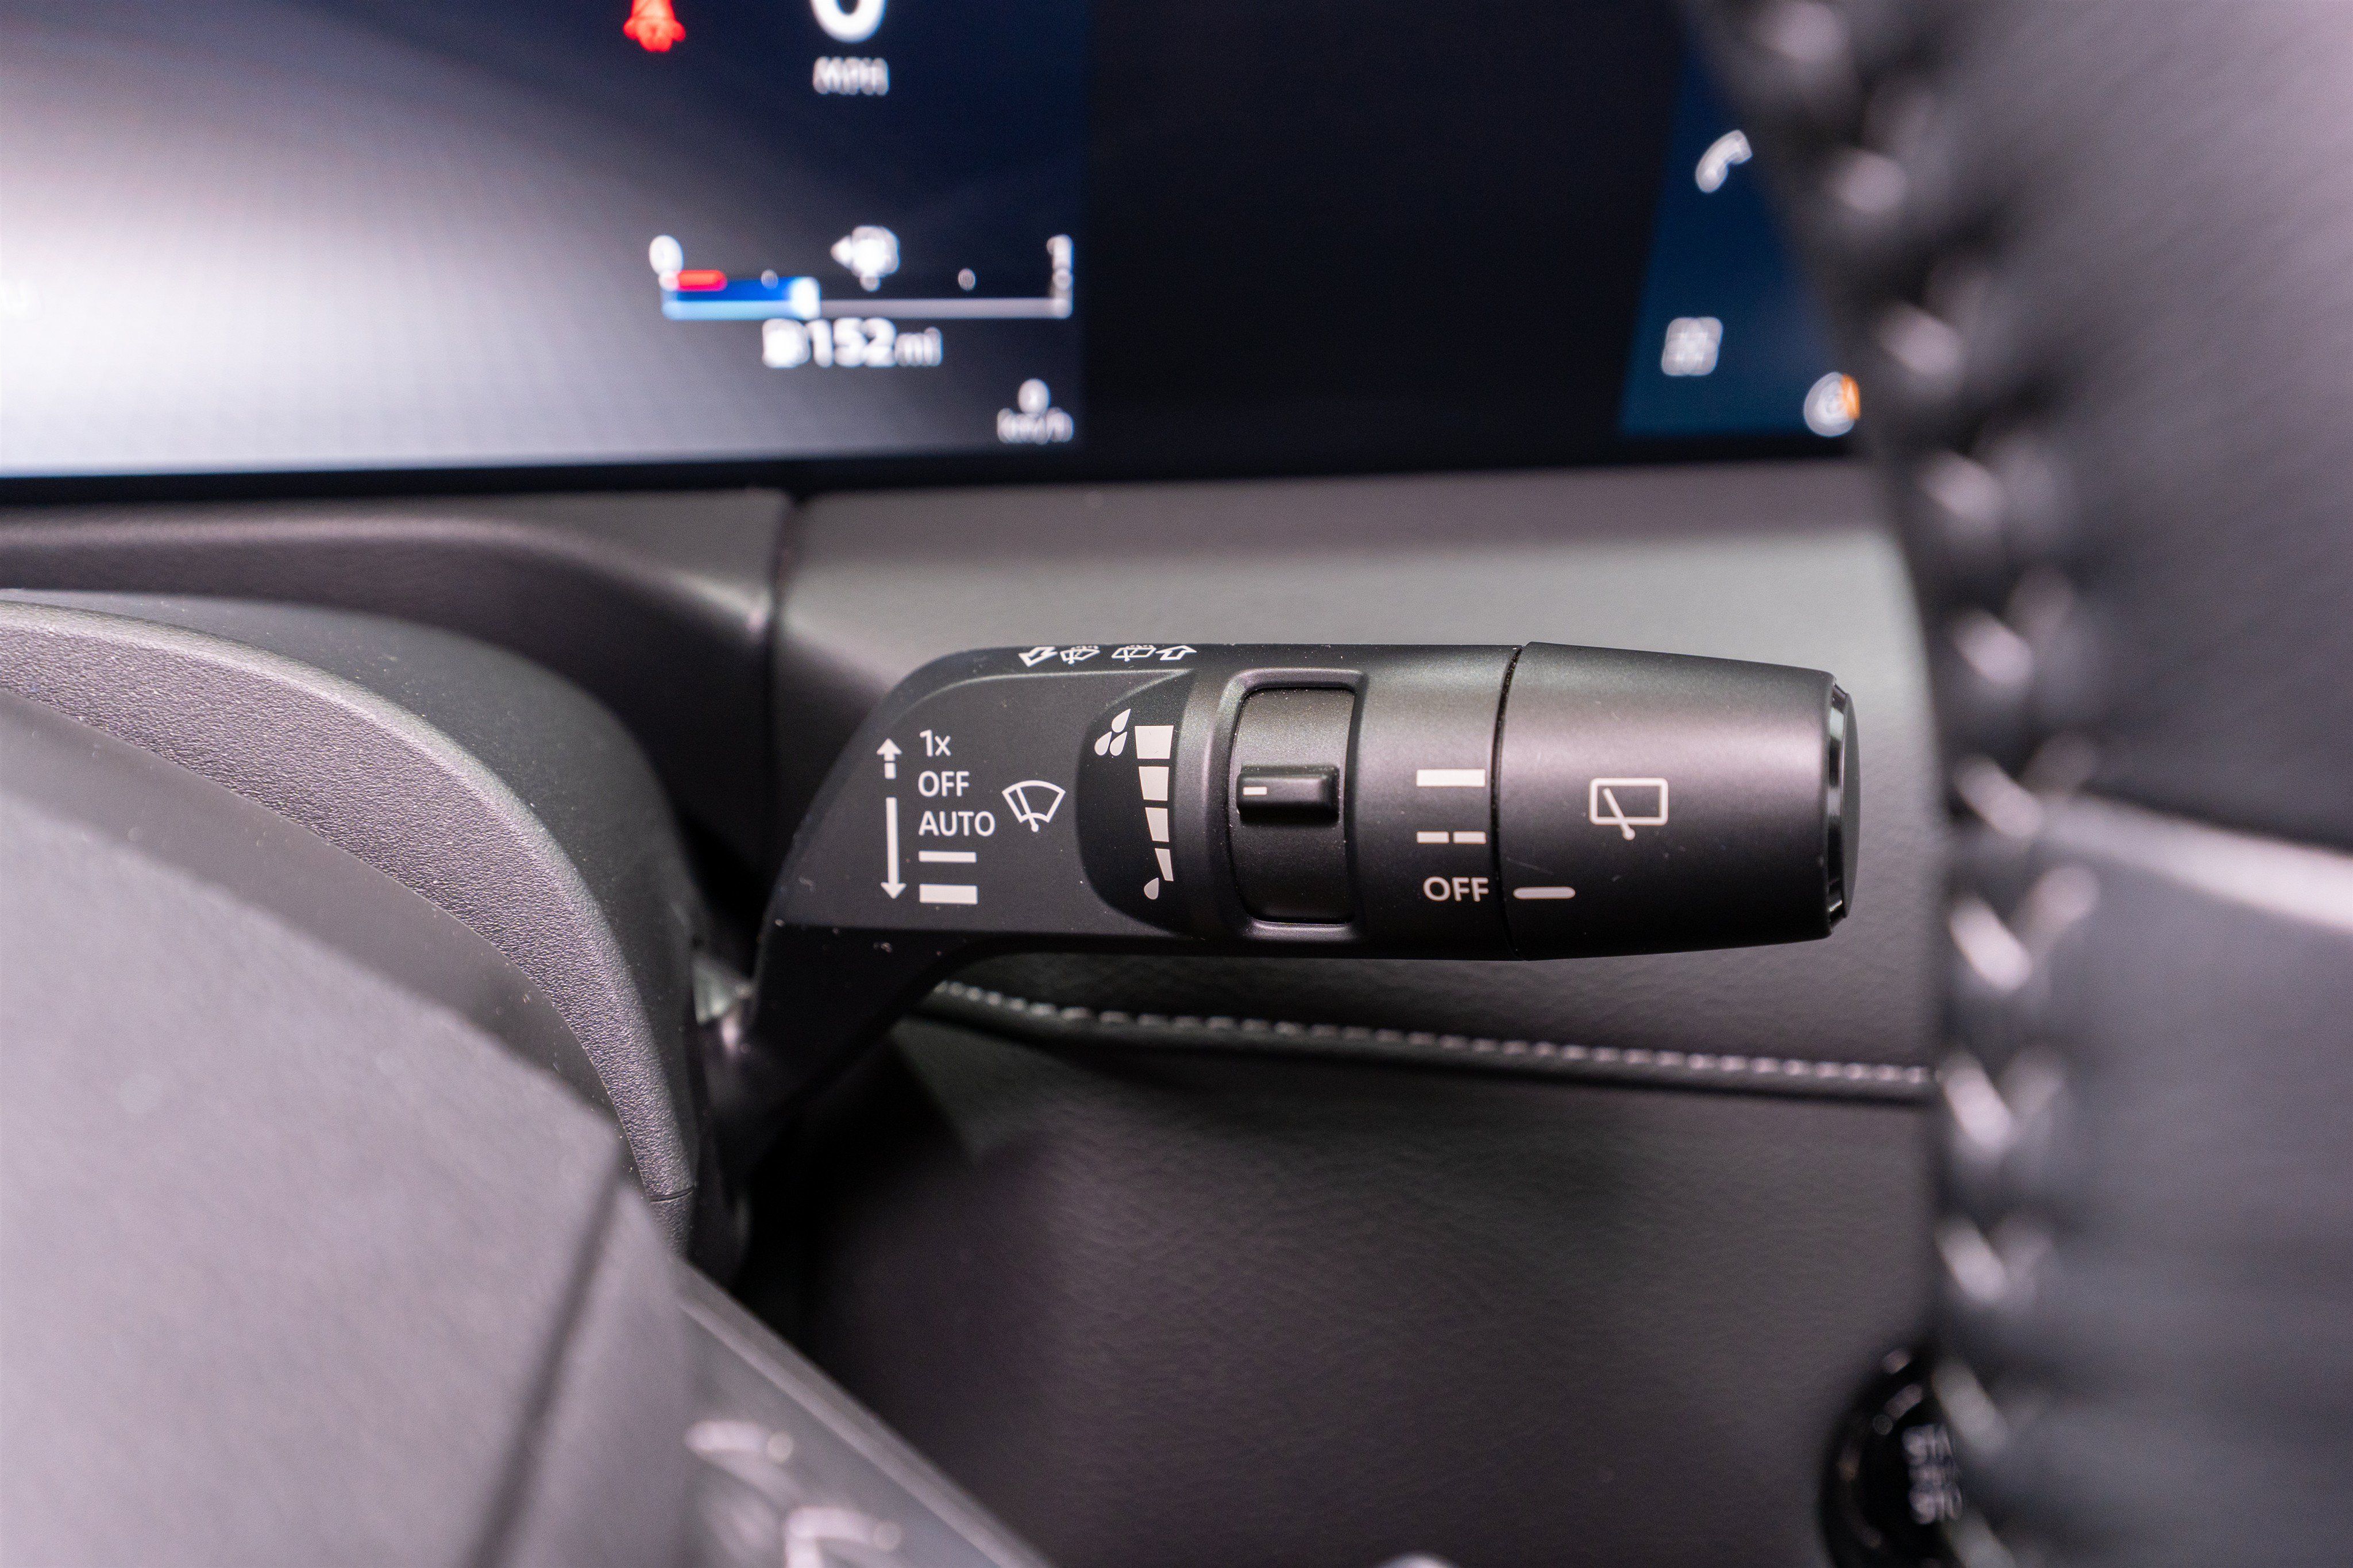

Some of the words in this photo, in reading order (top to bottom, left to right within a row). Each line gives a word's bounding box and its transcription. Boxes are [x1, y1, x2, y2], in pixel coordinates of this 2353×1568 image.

[919, 729, 951, 757] 1x
[918, 770, 970, 798] OFF
[918, 810, 996, 837] AUTO
[1423, 876, 1489, 902] OFF
